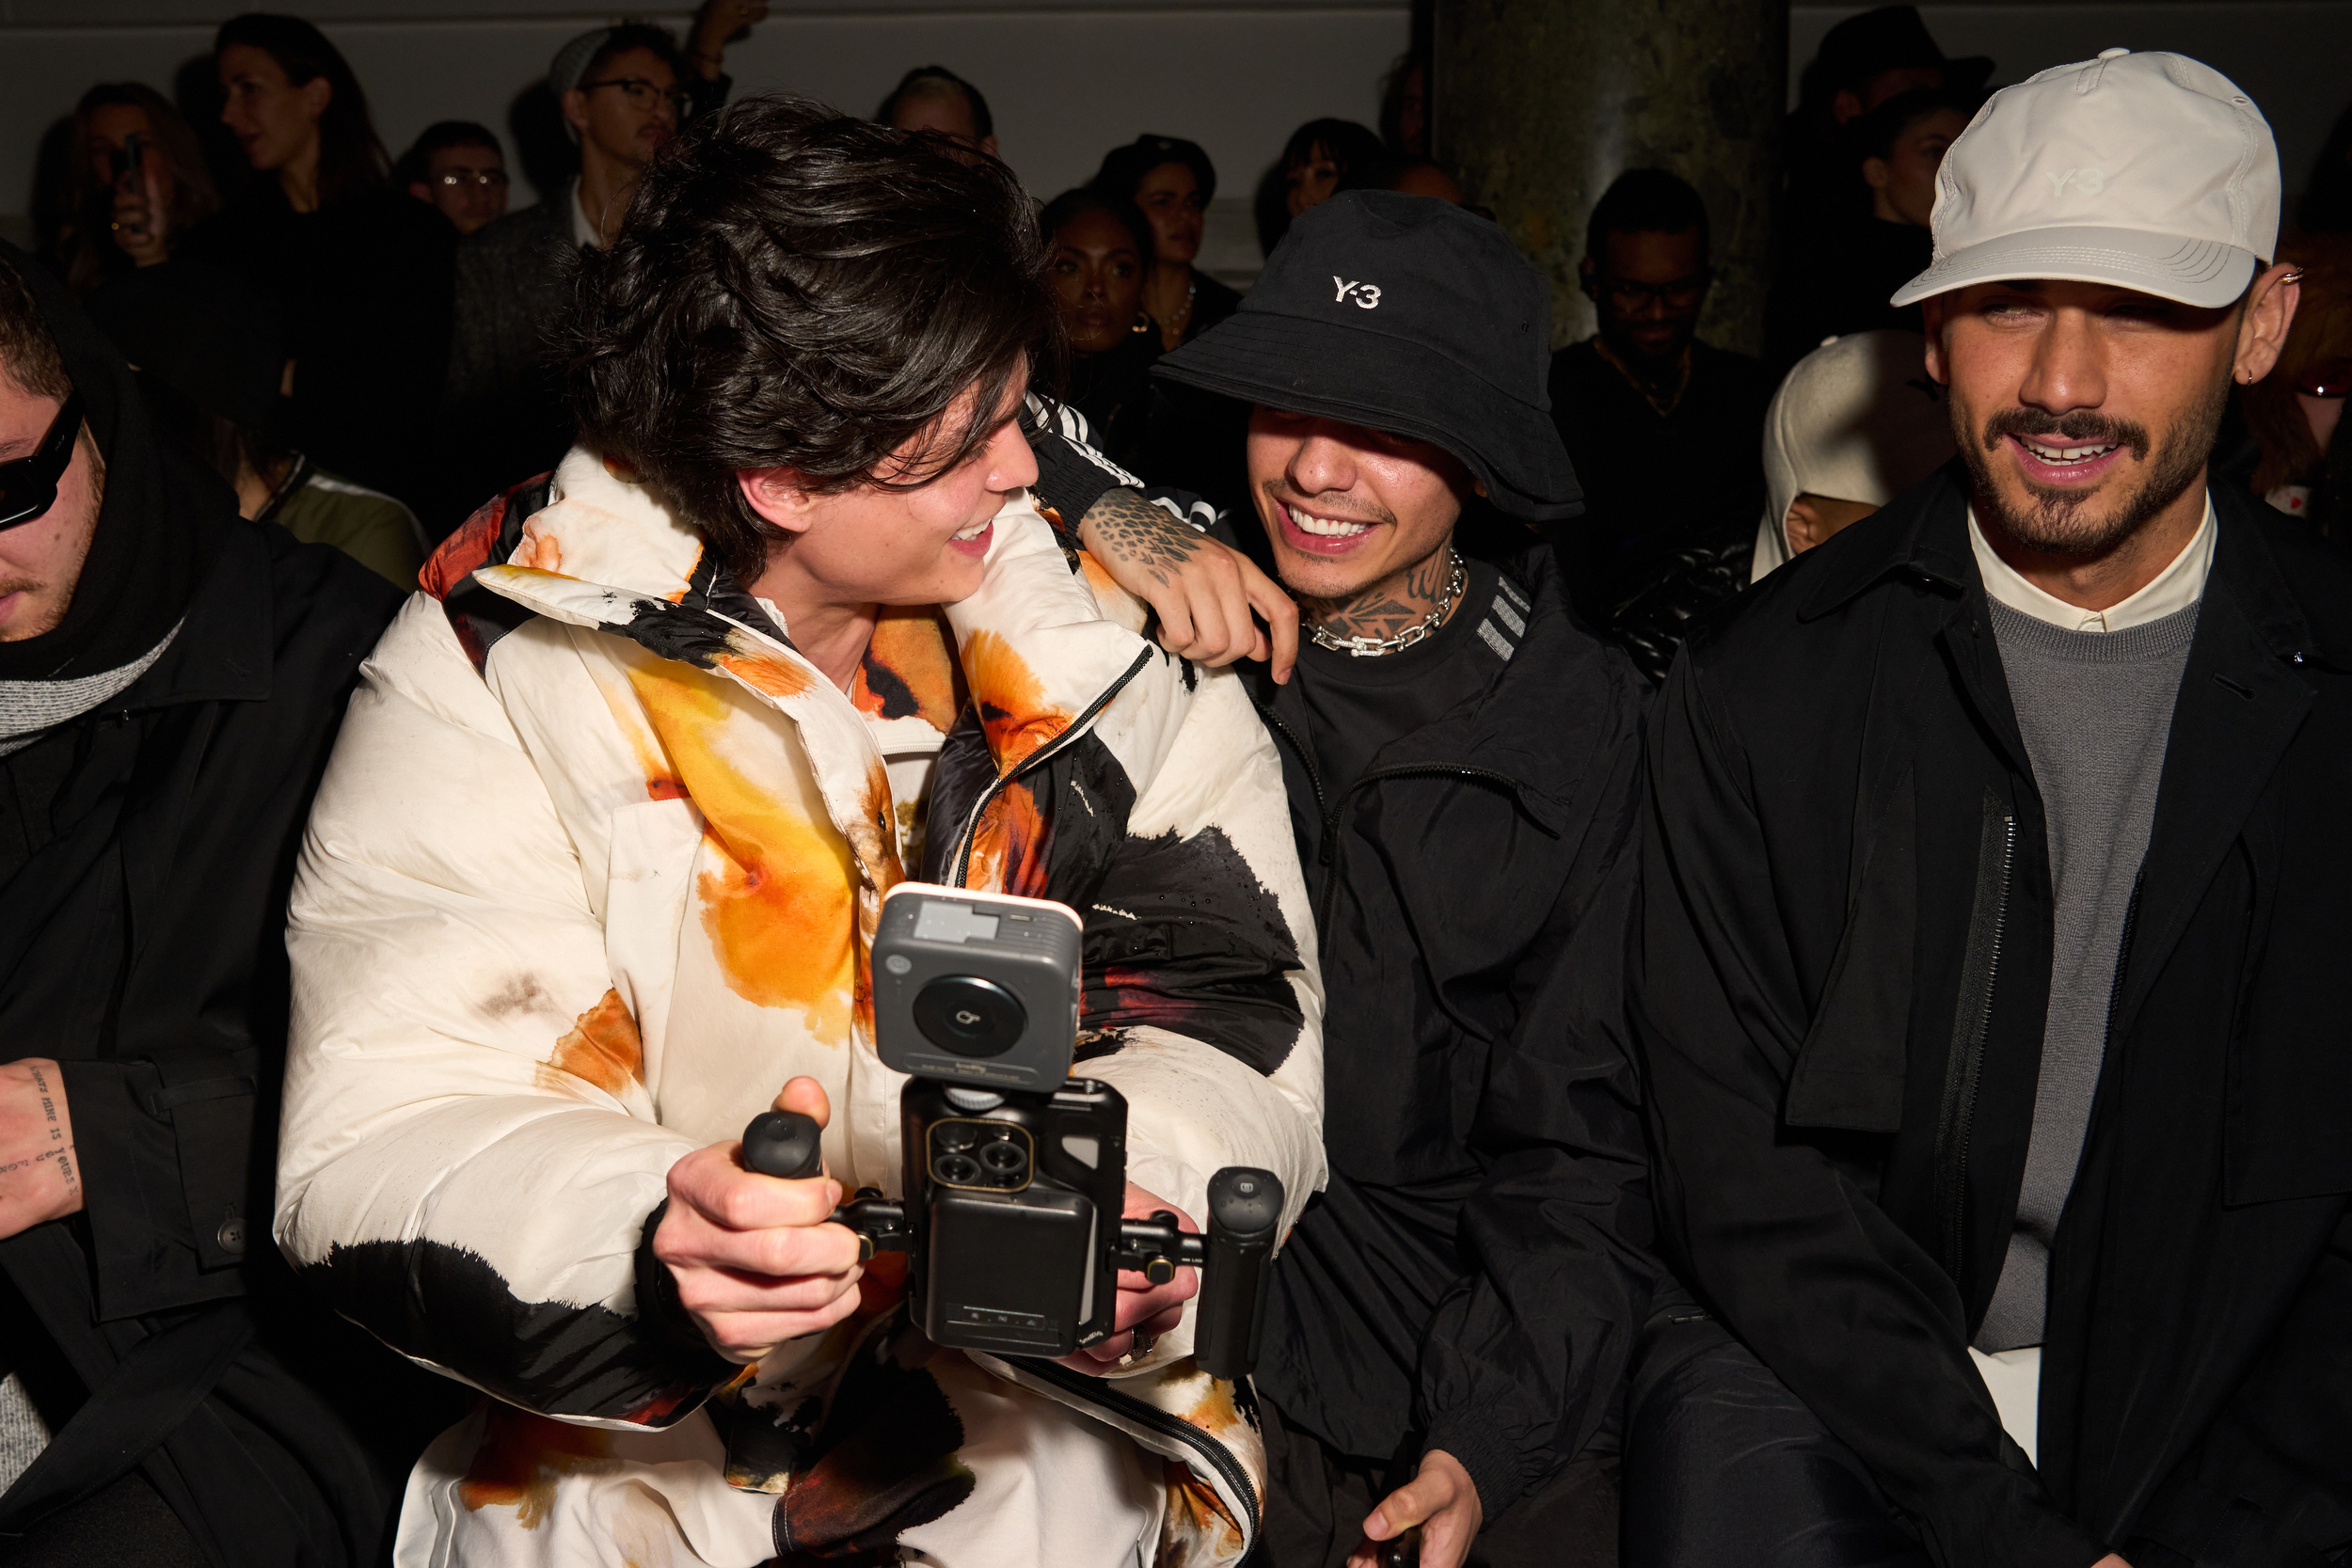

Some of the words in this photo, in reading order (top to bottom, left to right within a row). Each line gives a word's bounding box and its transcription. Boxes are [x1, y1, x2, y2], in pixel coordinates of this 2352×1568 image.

[2045, 167, 2104, 198] Y-3
[1332, 275, 1382, 309] Y-3
[41, 1097, 57, 1122] MINE
[50, 1127, 62, 1140] IS
